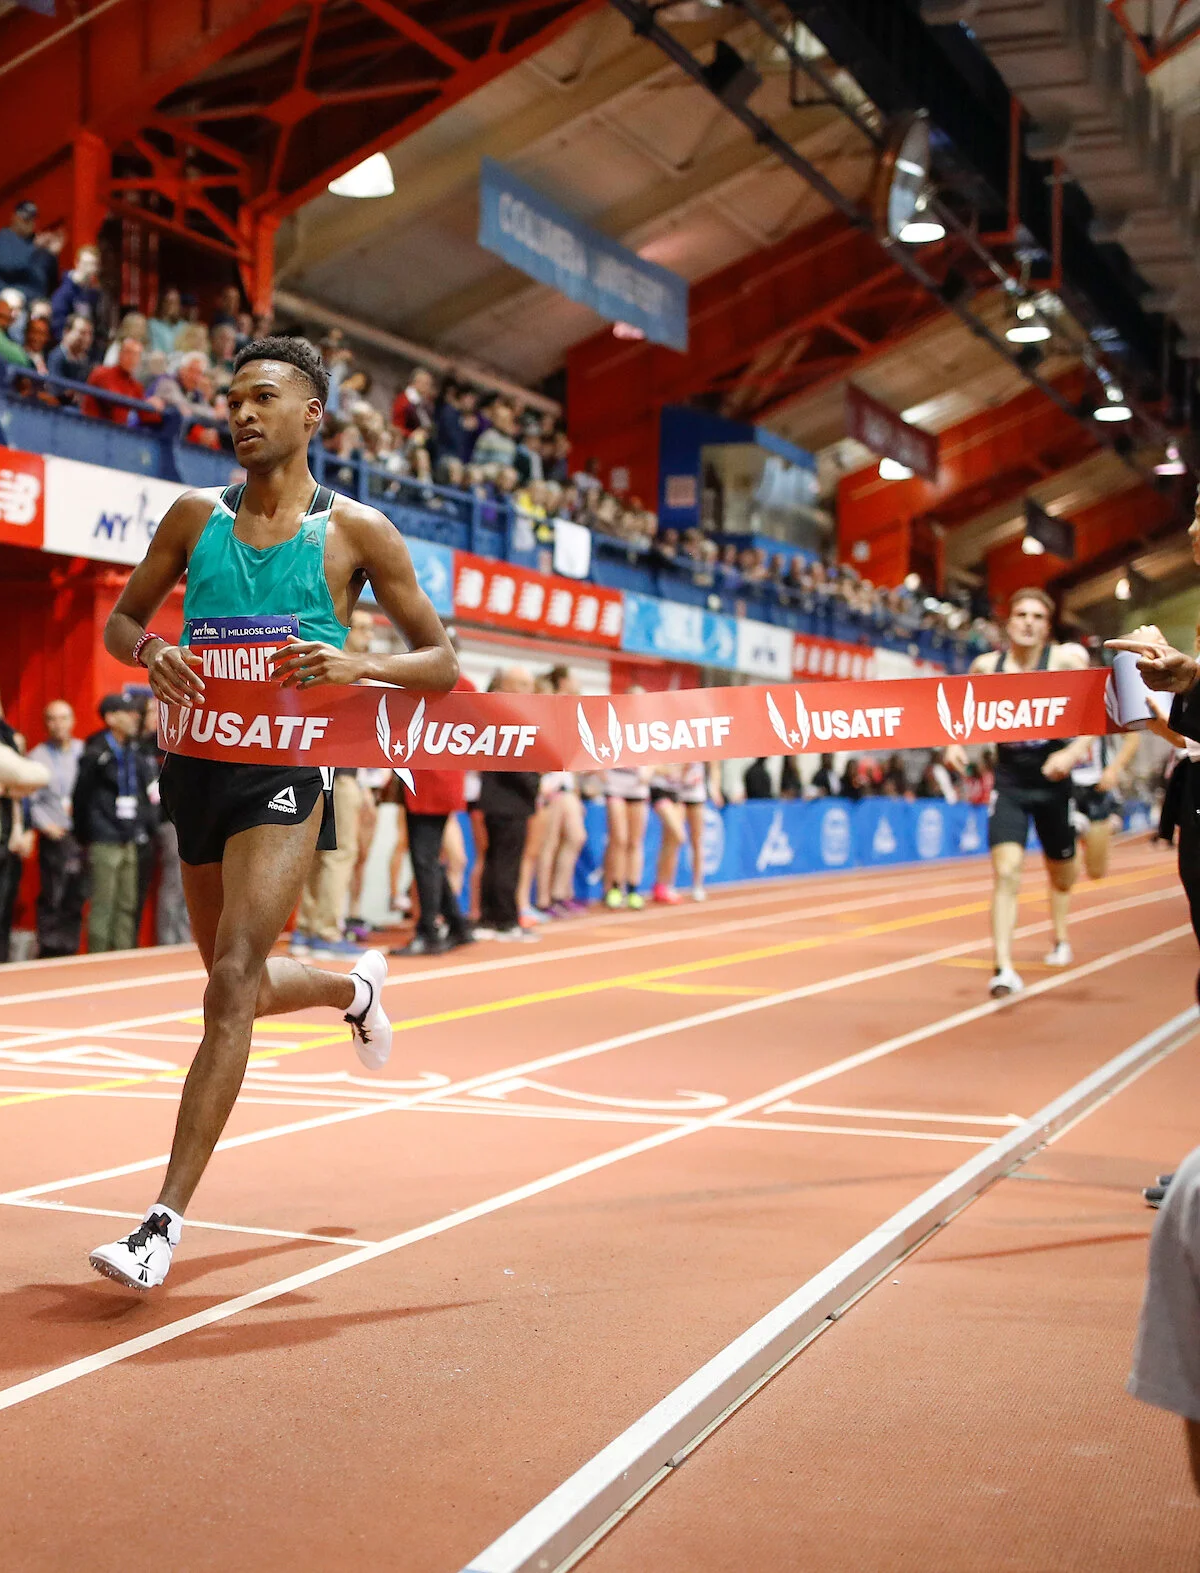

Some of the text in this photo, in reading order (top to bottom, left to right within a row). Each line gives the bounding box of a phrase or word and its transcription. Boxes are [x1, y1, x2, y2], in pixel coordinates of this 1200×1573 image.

[228, 626, 292, 637] MILLROSE GAMES
[191, 697, 1068, 757] USATF USATF USATF USATF USATF
[268, 801, 297, 814] Reebok
